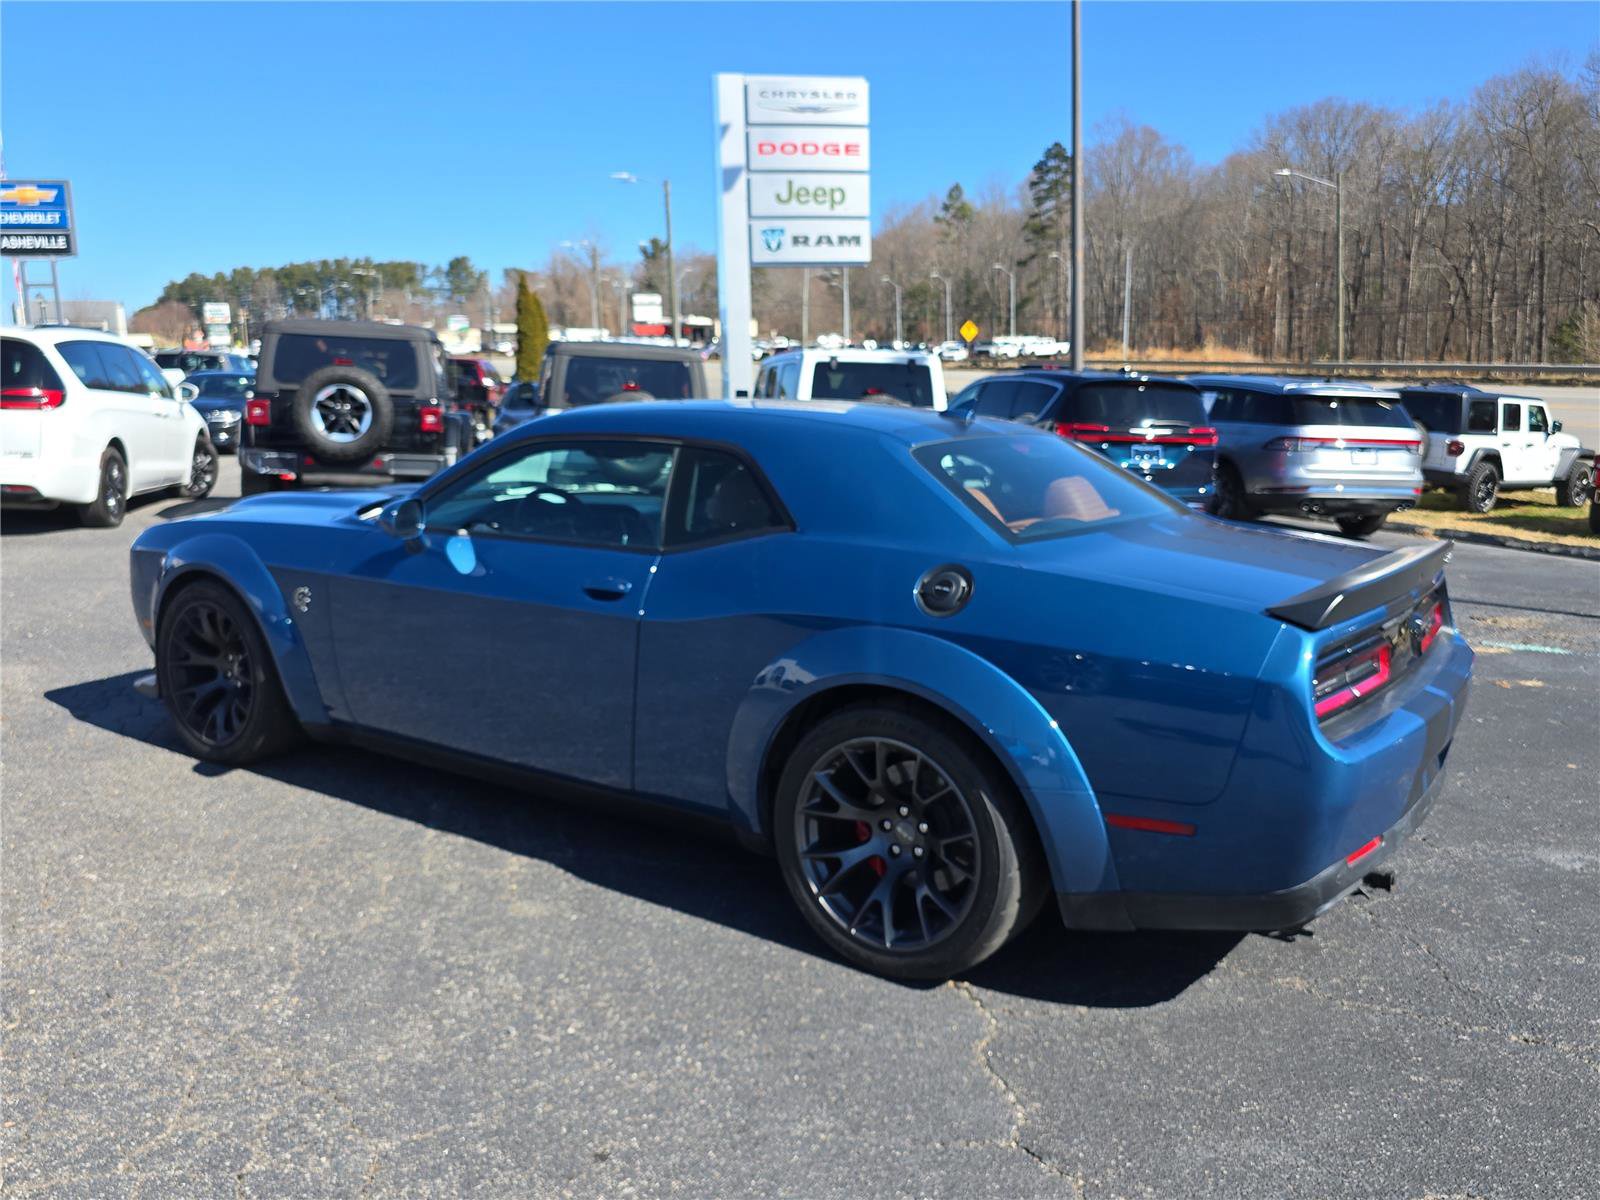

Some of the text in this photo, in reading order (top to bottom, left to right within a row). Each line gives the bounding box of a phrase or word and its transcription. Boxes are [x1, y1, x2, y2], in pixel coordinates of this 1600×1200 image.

[759, 90, 857, 99] CHRYSLER
[757, 142, 861, 156] DODGE
[775, 180, 846, 210] Jeep
[1, 235, 67, 249] ASHEVILLE
[792, 235, 861, 247] RAM
